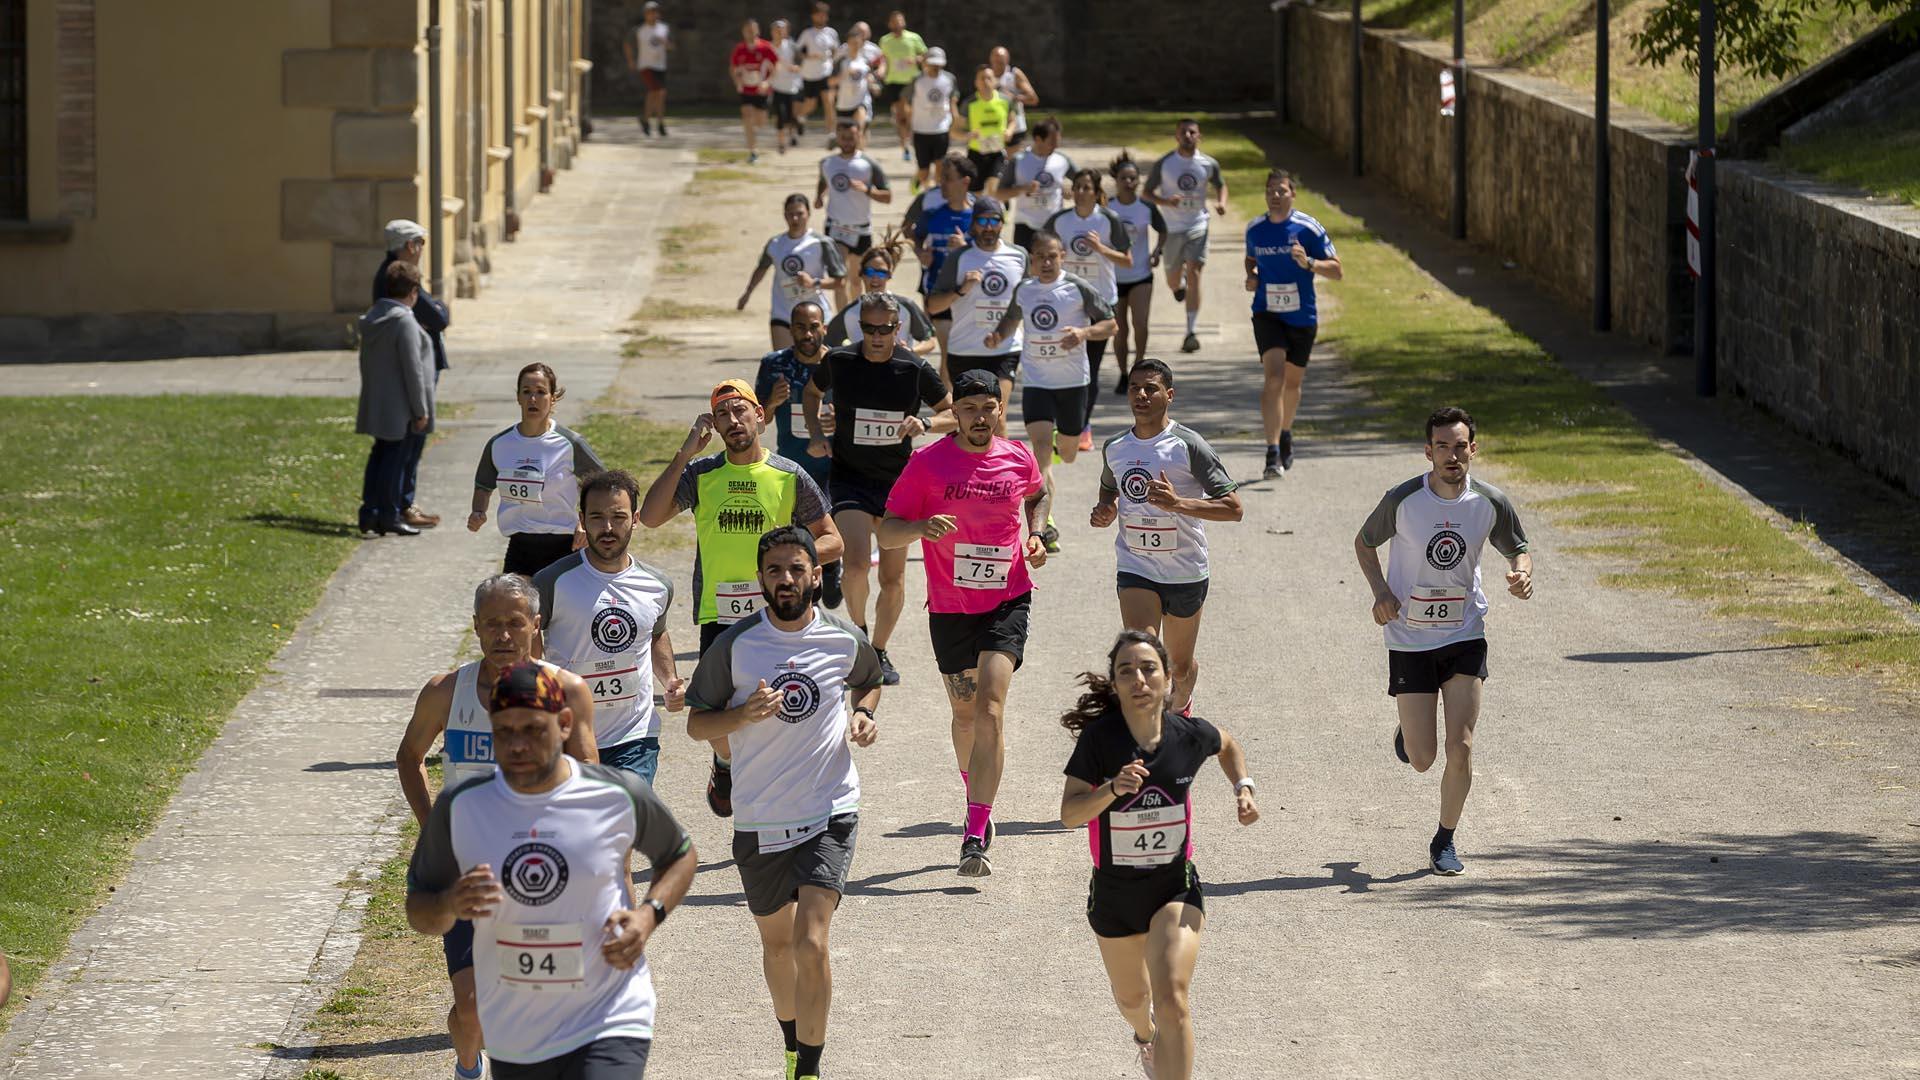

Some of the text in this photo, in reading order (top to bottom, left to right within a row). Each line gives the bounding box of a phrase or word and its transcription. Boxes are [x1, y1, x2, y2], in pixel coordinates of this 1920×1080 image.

[1275, 295, 1290, 305] 79
[1040, 346, 1057, 356] 52
[864, 424, 895, 437] 110
[509, 484, 528, 498] 68
[1140, 532, 1161, 547] 13
[971, 562, 995, 578] 75
[730, 599, 755, 614] 64
[1424, 604, 1448, 618] 48
[593, 678, 623, 697] 43
[1134, 831, 1167, 851] 42
[518, 952, 557, 975] 94
